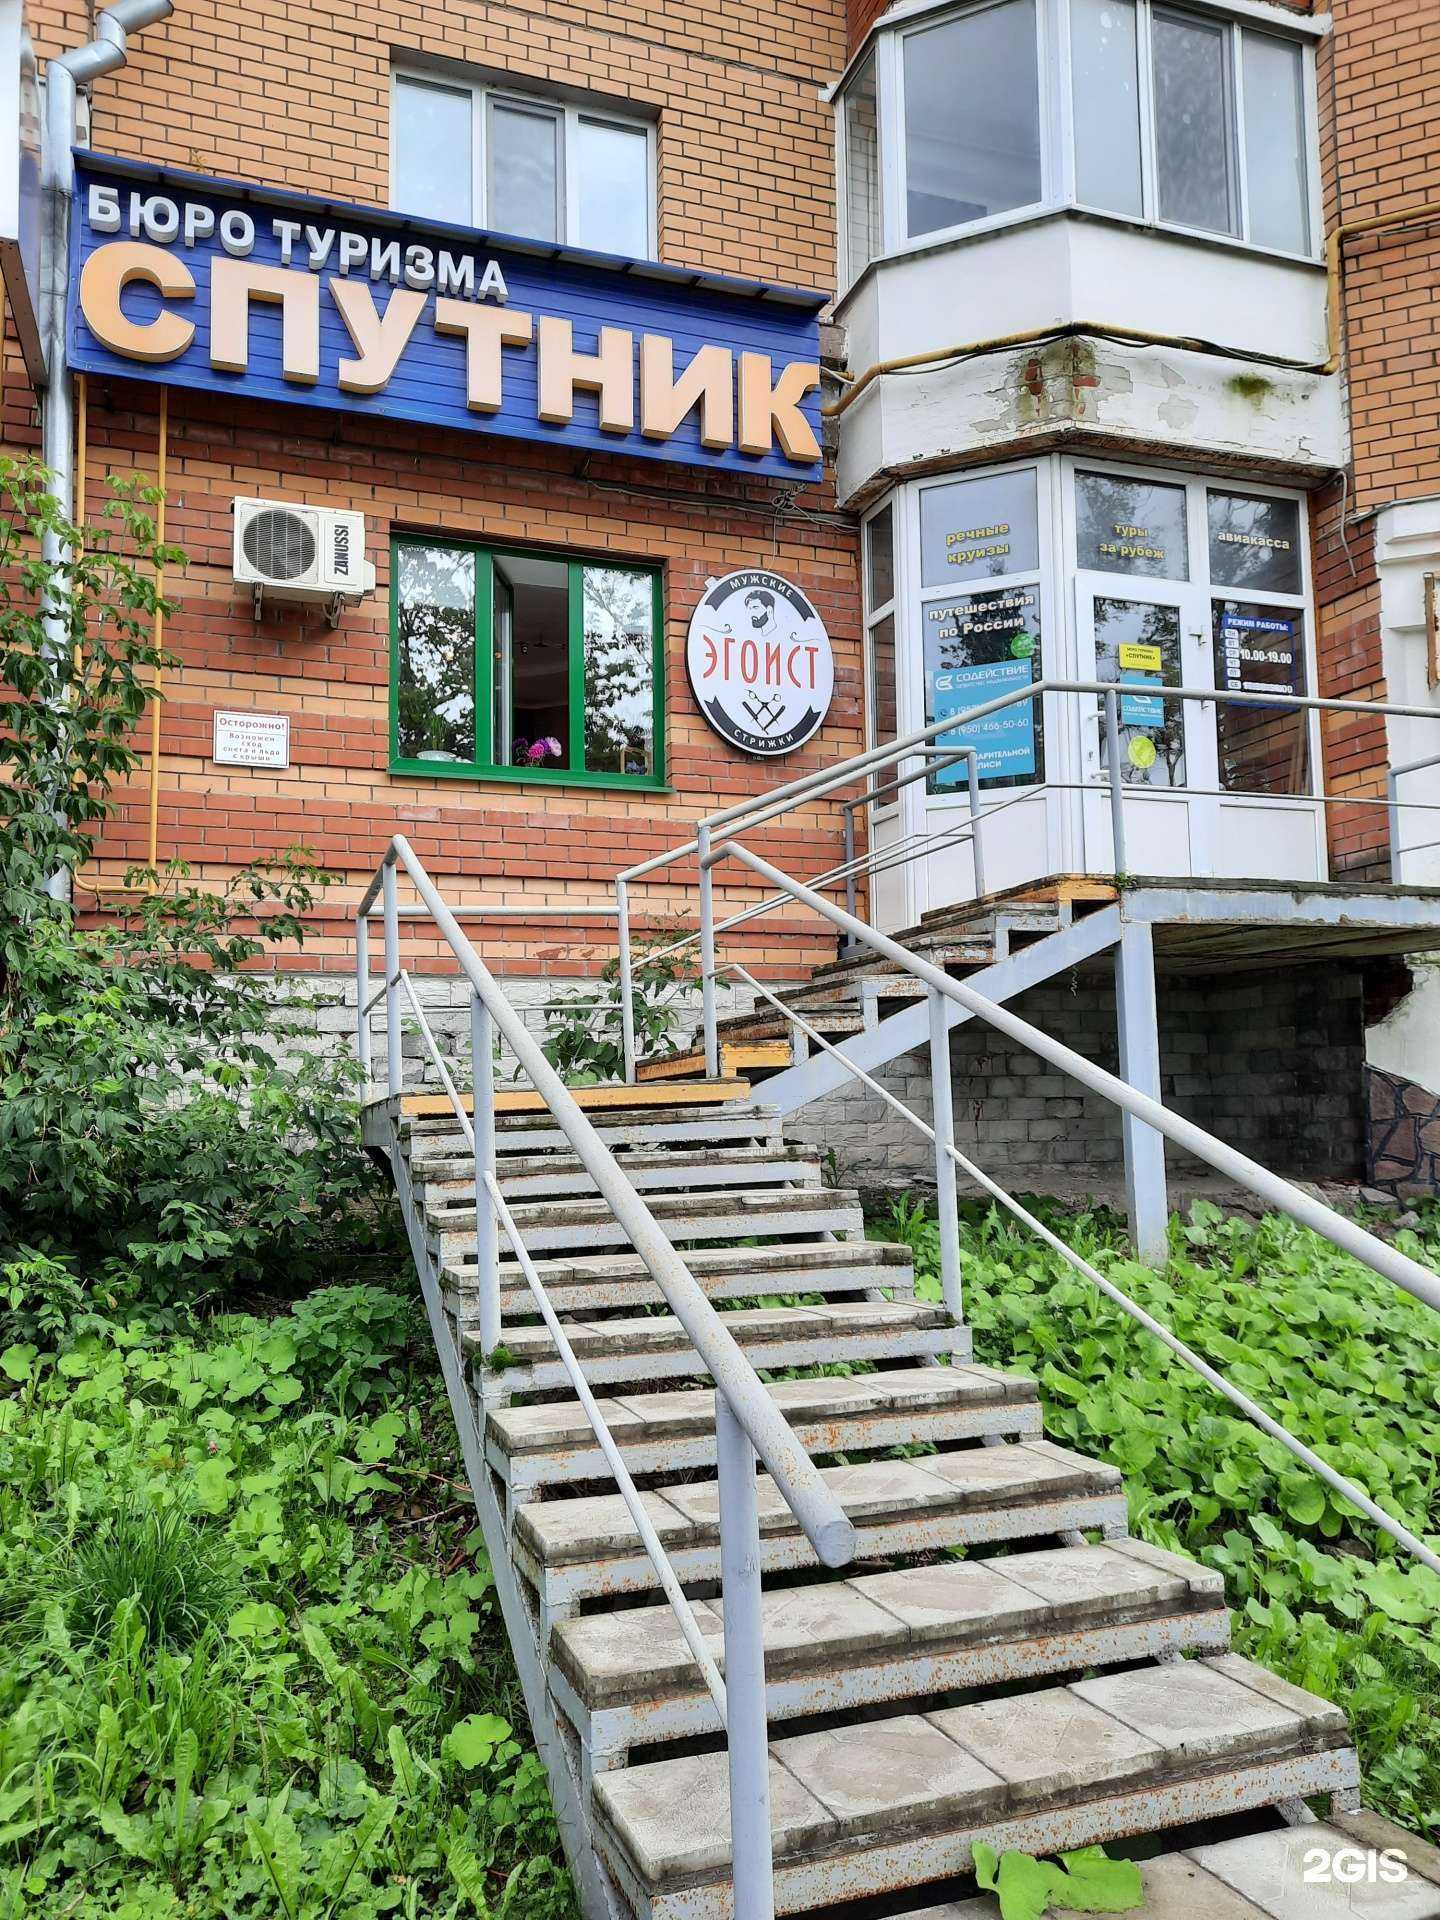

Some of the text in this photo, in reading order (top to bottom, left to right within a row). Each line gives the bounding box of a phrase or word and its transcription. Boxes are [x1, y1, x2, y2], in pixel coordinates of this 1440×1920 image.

[88, 183, 508, 303] БЮРО ТУРИЗМА
[79, 241, 823, 463] СПУТНИК
[945, 523, 1009, 545] речные
[1114, 523, 1149, 538] туры
[1217, 530, 1290, 550] авиакасса
[333, 524, 349, 576] ZANUSSI
[947, 543, 1009, 564] круизы
[1099, 541, 1165, 560] за рубеж
[729, 575, 794, 598] МУЖСКИЕ
[928, 594, 1034, 621] путешествия
[938, 616, 1024, 638] по России
[1227, 617, 1255, 628] РЕЖИМ
[702, 634, 819, 690] ЭГОИСТ
[956, 664, 1029, 682] СОДЕЙСТВИЕ
[219, 717, 285, 731] Осторожно!
[733, 729, 794, 748] СТРИЖКИ
